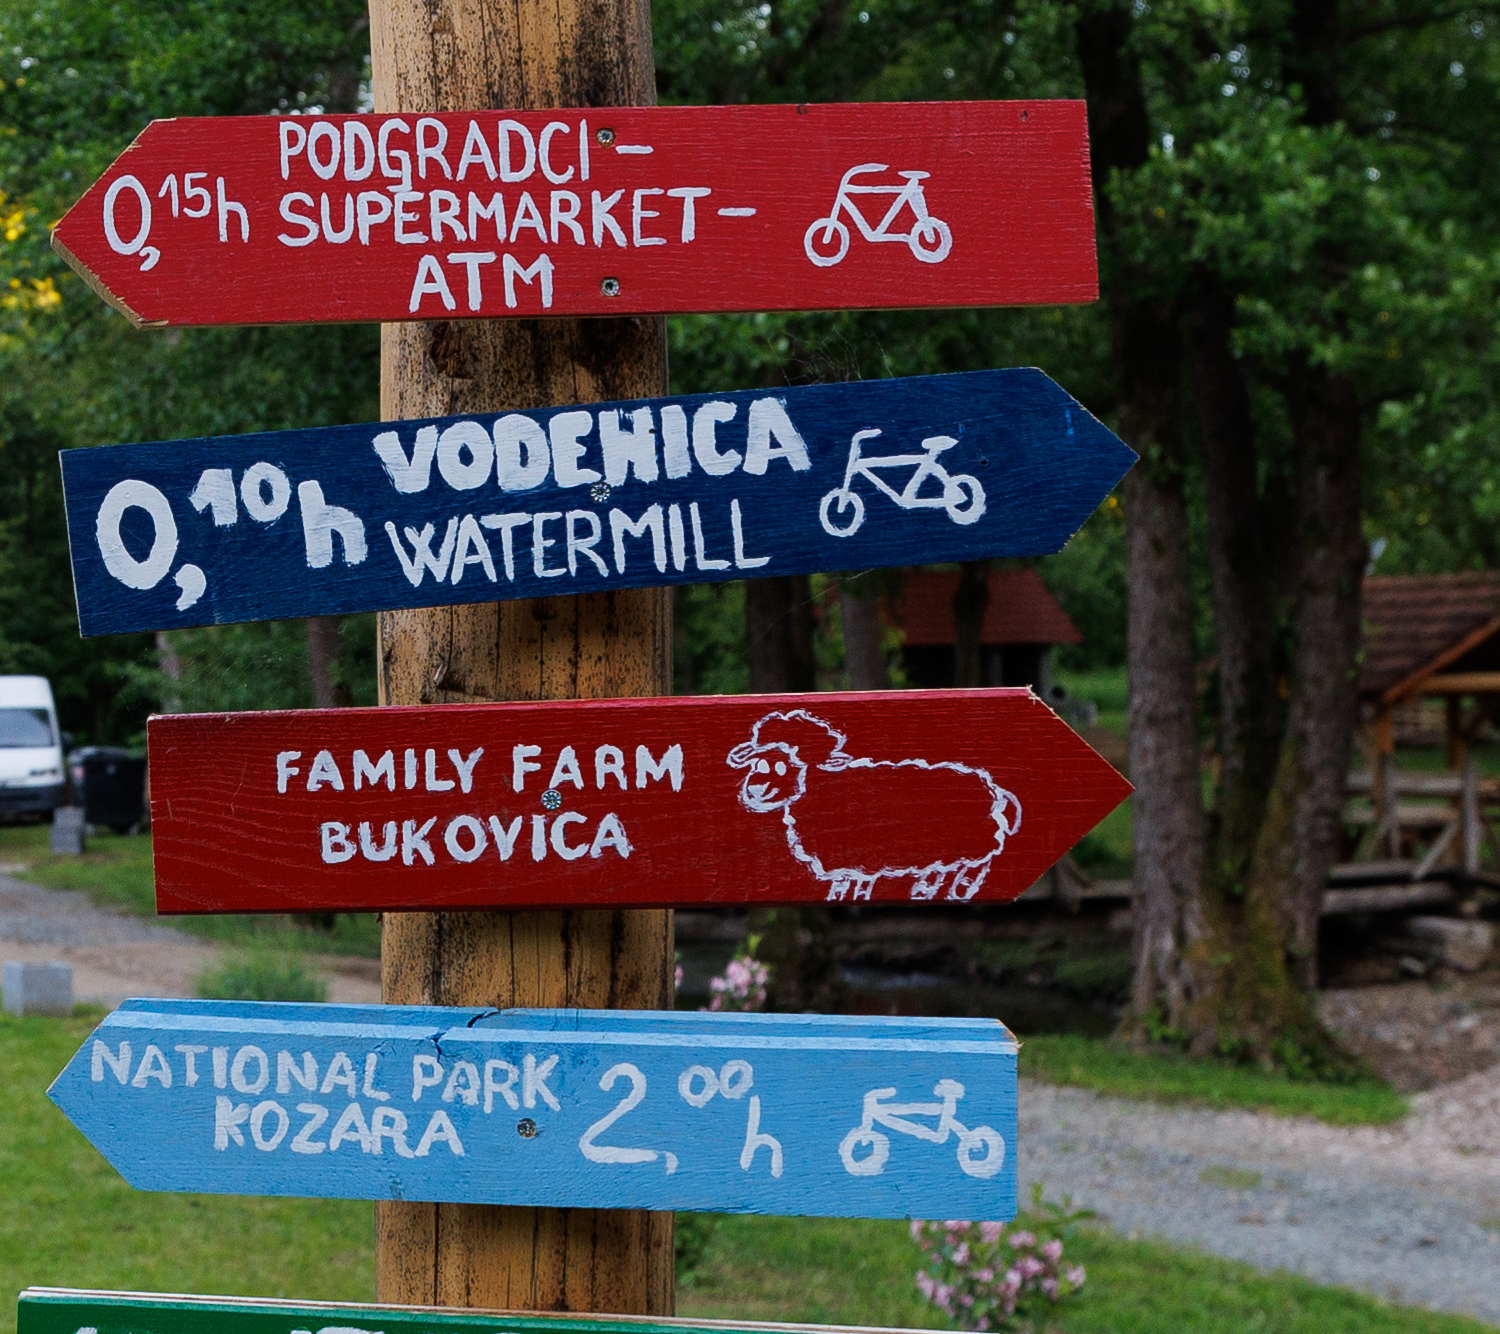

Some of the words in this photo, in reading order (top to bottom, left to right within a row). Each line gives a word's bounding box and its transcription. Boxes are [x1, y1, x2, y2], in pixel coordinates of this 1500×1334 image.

[410, 252, 554, 312] ATM
[385, 499, 770, 585] WATERMILL
[277, 748, 483, 793] FAMILY
[513, 744, 684, 792] FARM
[321, 812, 633, 865] BUKOVICA
[91, 1039, 391, 1102] NATIONAL
[412, 1054, 560, 1113] PARK
[214, 1095, 466, 1159] KOZARA
